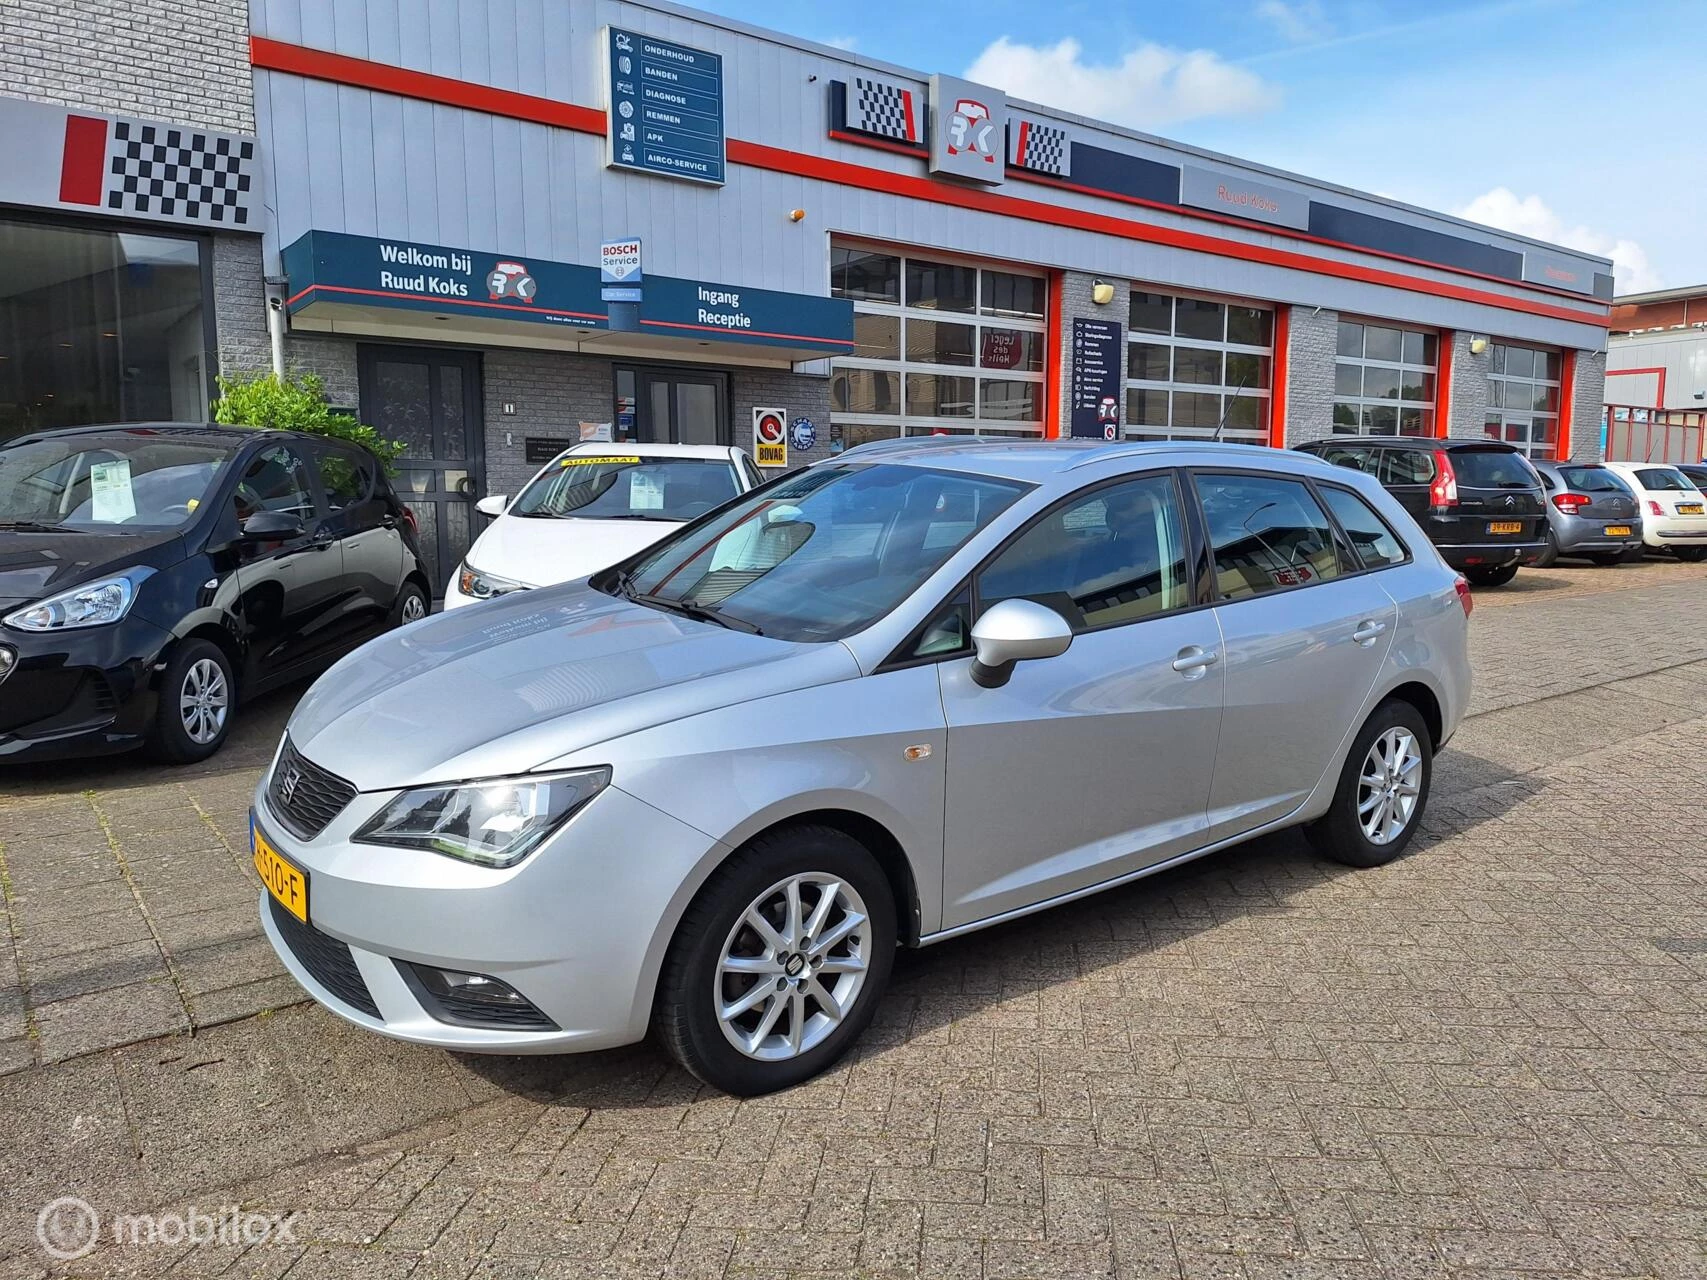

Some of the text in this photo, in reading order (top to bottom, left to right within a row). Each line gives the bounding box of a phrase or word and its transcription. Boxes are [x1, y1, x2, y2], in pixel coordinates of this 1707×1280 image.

[644, 44, 694, 63] ONDERHOUD
[645, 67, 678, 81] BANDEN
[645, 90, 686, 105] DIAGNOSE
[646, 110, 681, 124] REMMEN
[646, 133, 664, 142] APK
[648, 154, 707, 172] AIRCO-SERVICE
[1217, 184, 1248, 206] Ruud
[602, 244, 638, 256] BOSCH
[380, 244, 472, 276] Welkom bij
[602, 256, 638, 266] Service
[380, 271, 468, 297] Ruud Koks
[698, 286, 740, 308] Ingang
[698, 308, 751, 329] Receptie
[566, 457, 635, 466] AUTOMAAT
[759, 447, 784, 461] BOVAG
